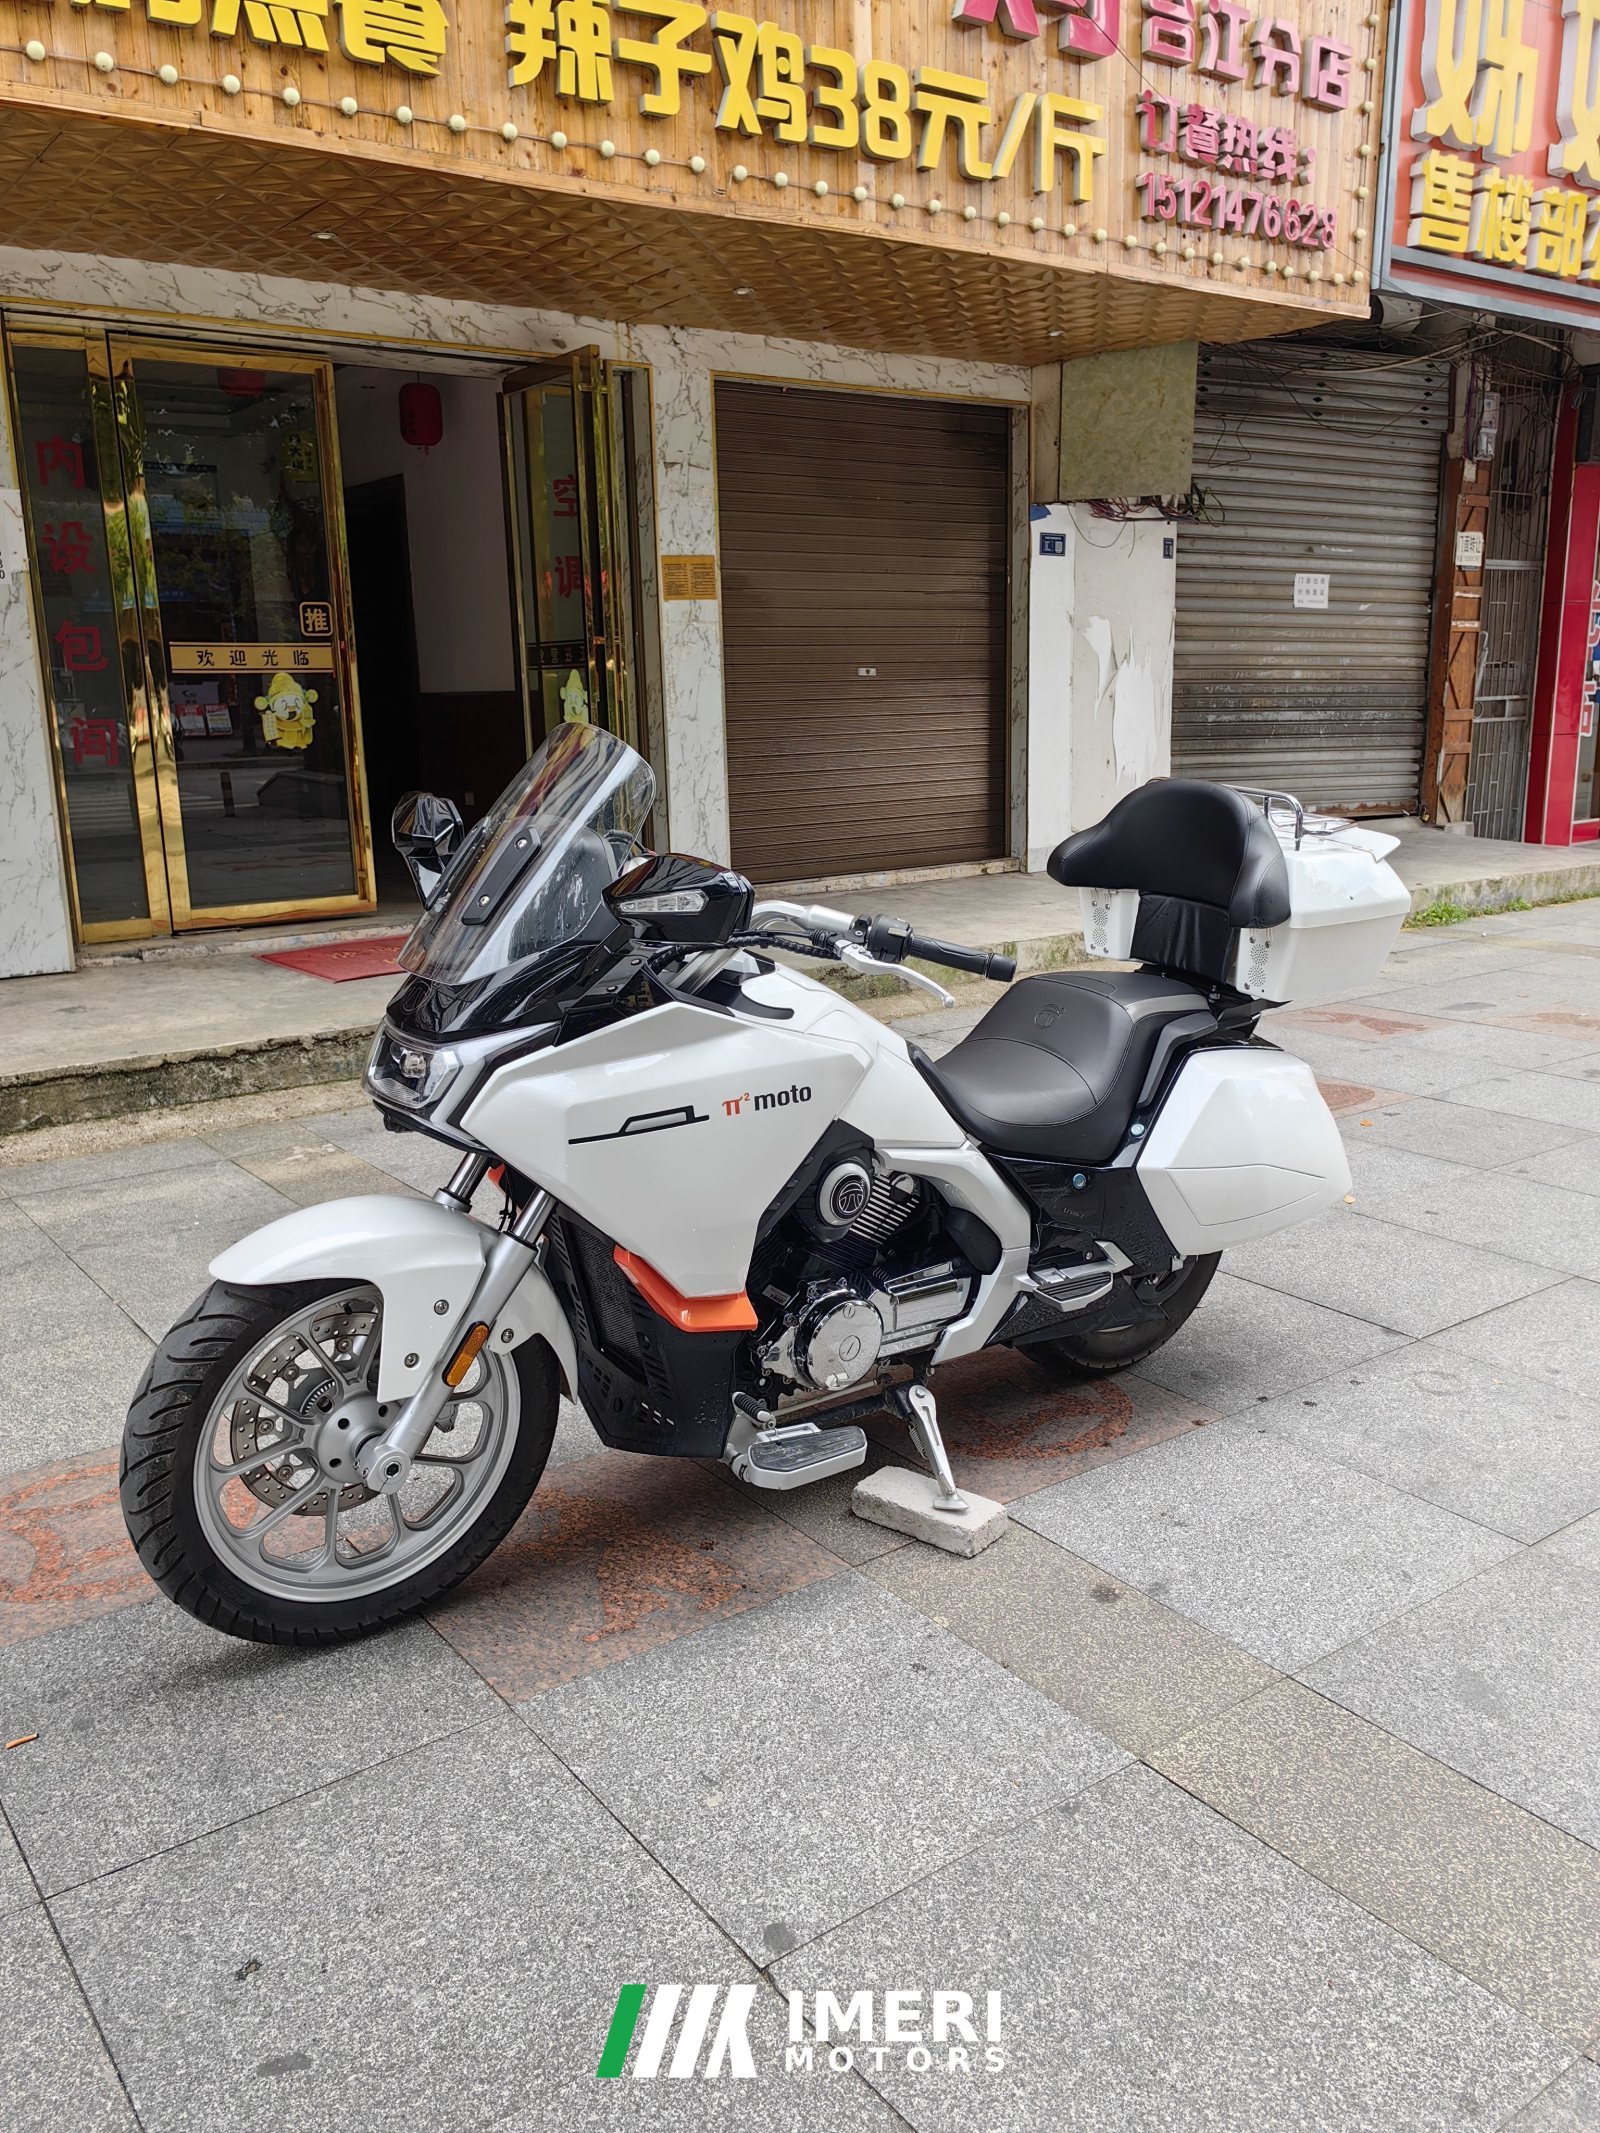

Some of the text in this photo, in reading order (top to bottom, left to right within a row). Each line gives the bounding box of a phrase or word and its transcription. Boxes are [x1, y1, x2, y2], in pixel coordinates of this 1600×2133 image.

[1137, 171, 1337, 250] 15121476628
[36, 434, 120, 768] 内设包间
[304, 607, 329, 633] 推
[196, 649, 310, 667] 欢迎光临
[754, 1084, 812, 1111] moto
